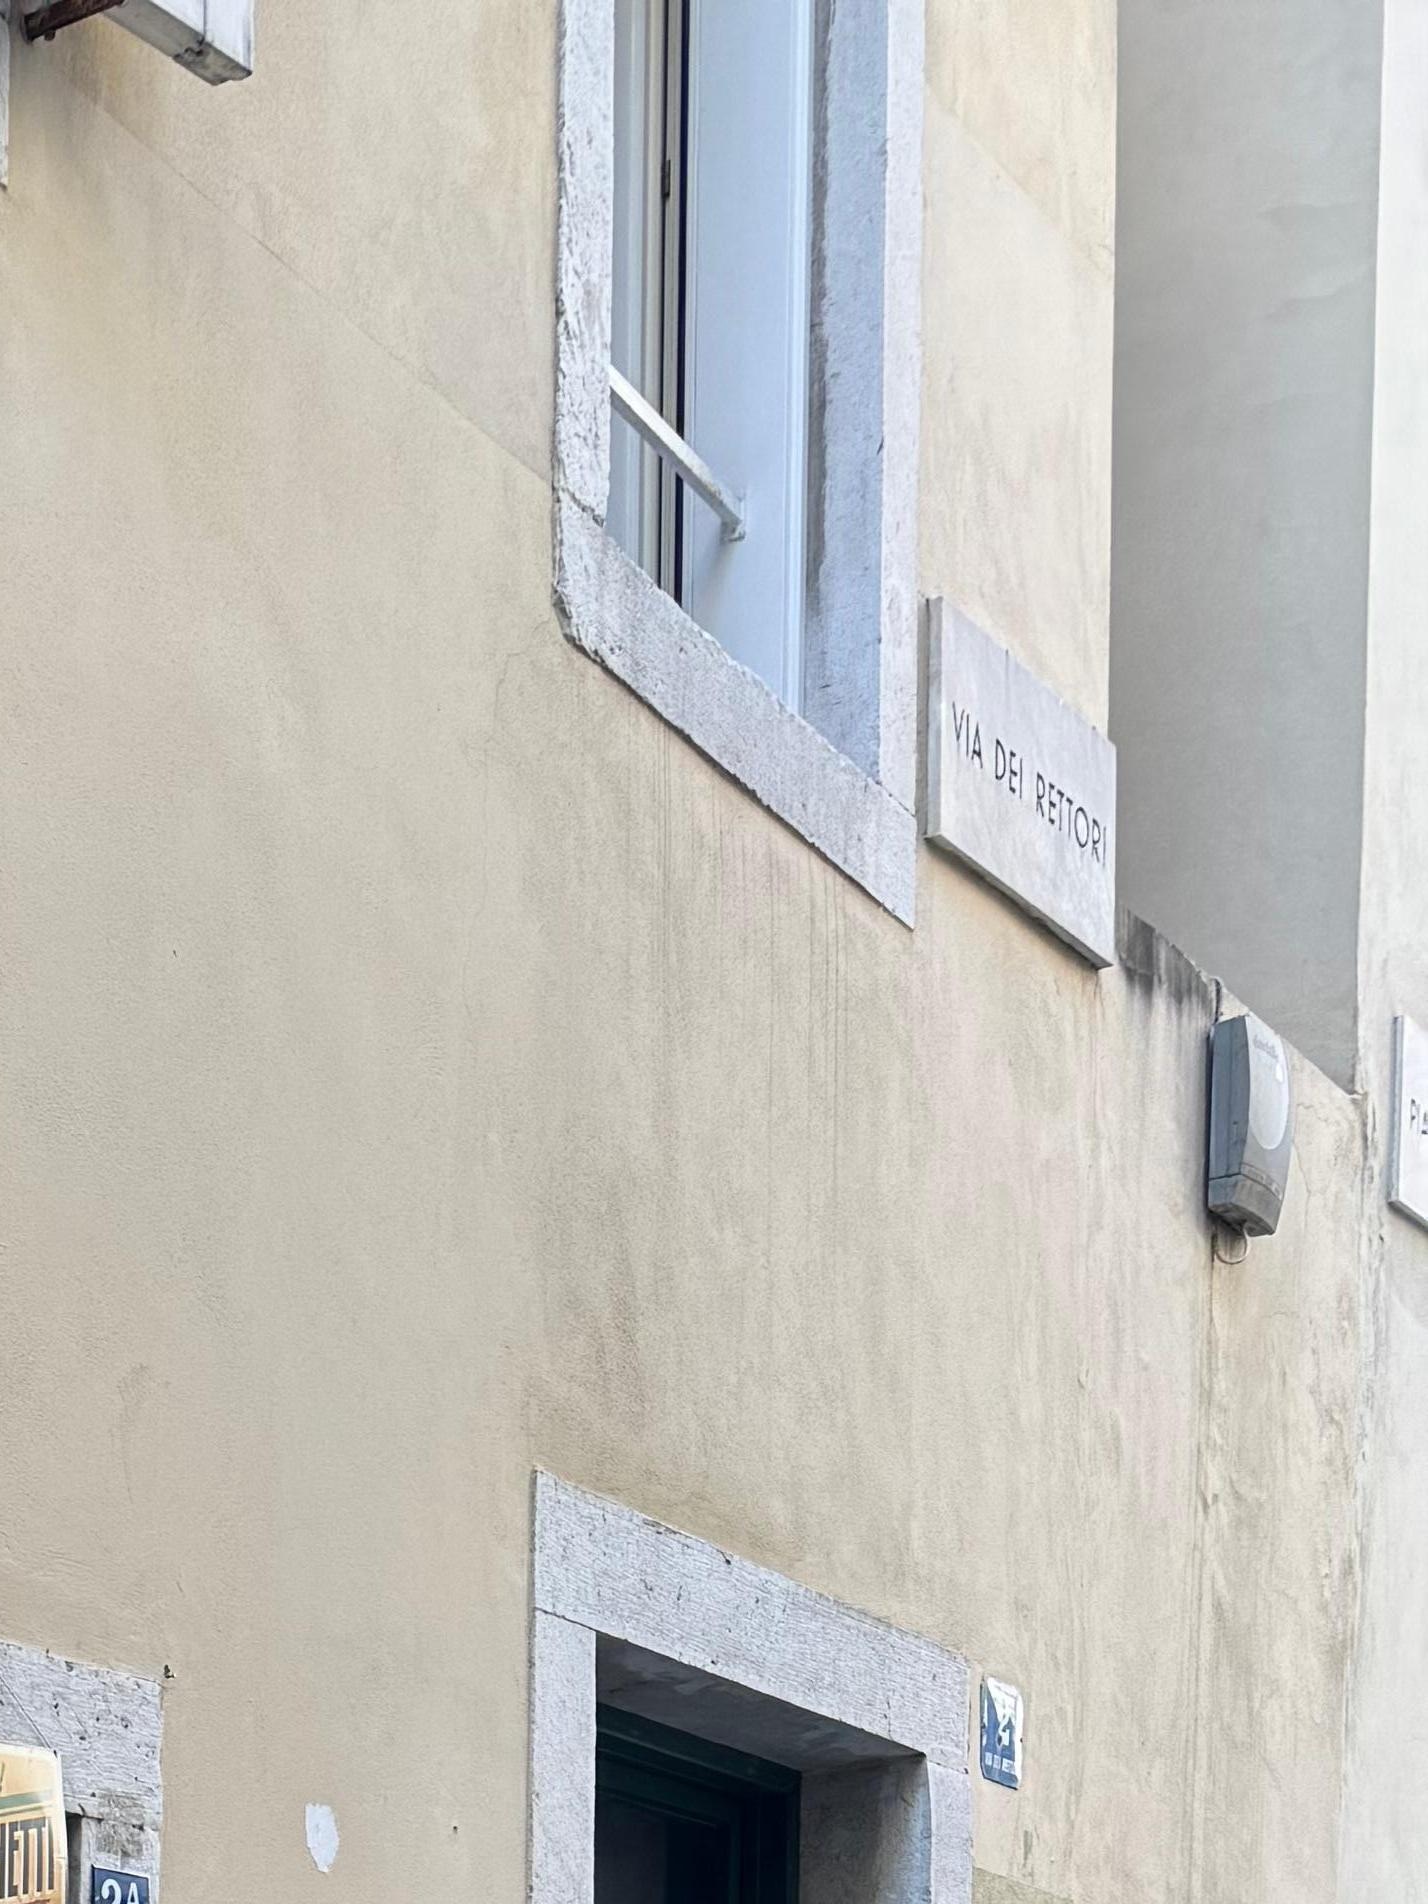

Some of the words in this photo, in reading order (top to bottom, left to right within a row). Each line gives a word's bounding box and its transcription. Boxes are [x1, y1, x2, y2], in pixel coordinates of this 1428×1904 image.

[952, 701, 983, 769] VIA
[995, 738, 1023, 799] DEI
[1036, 771, 1107, 868] RETTORI
